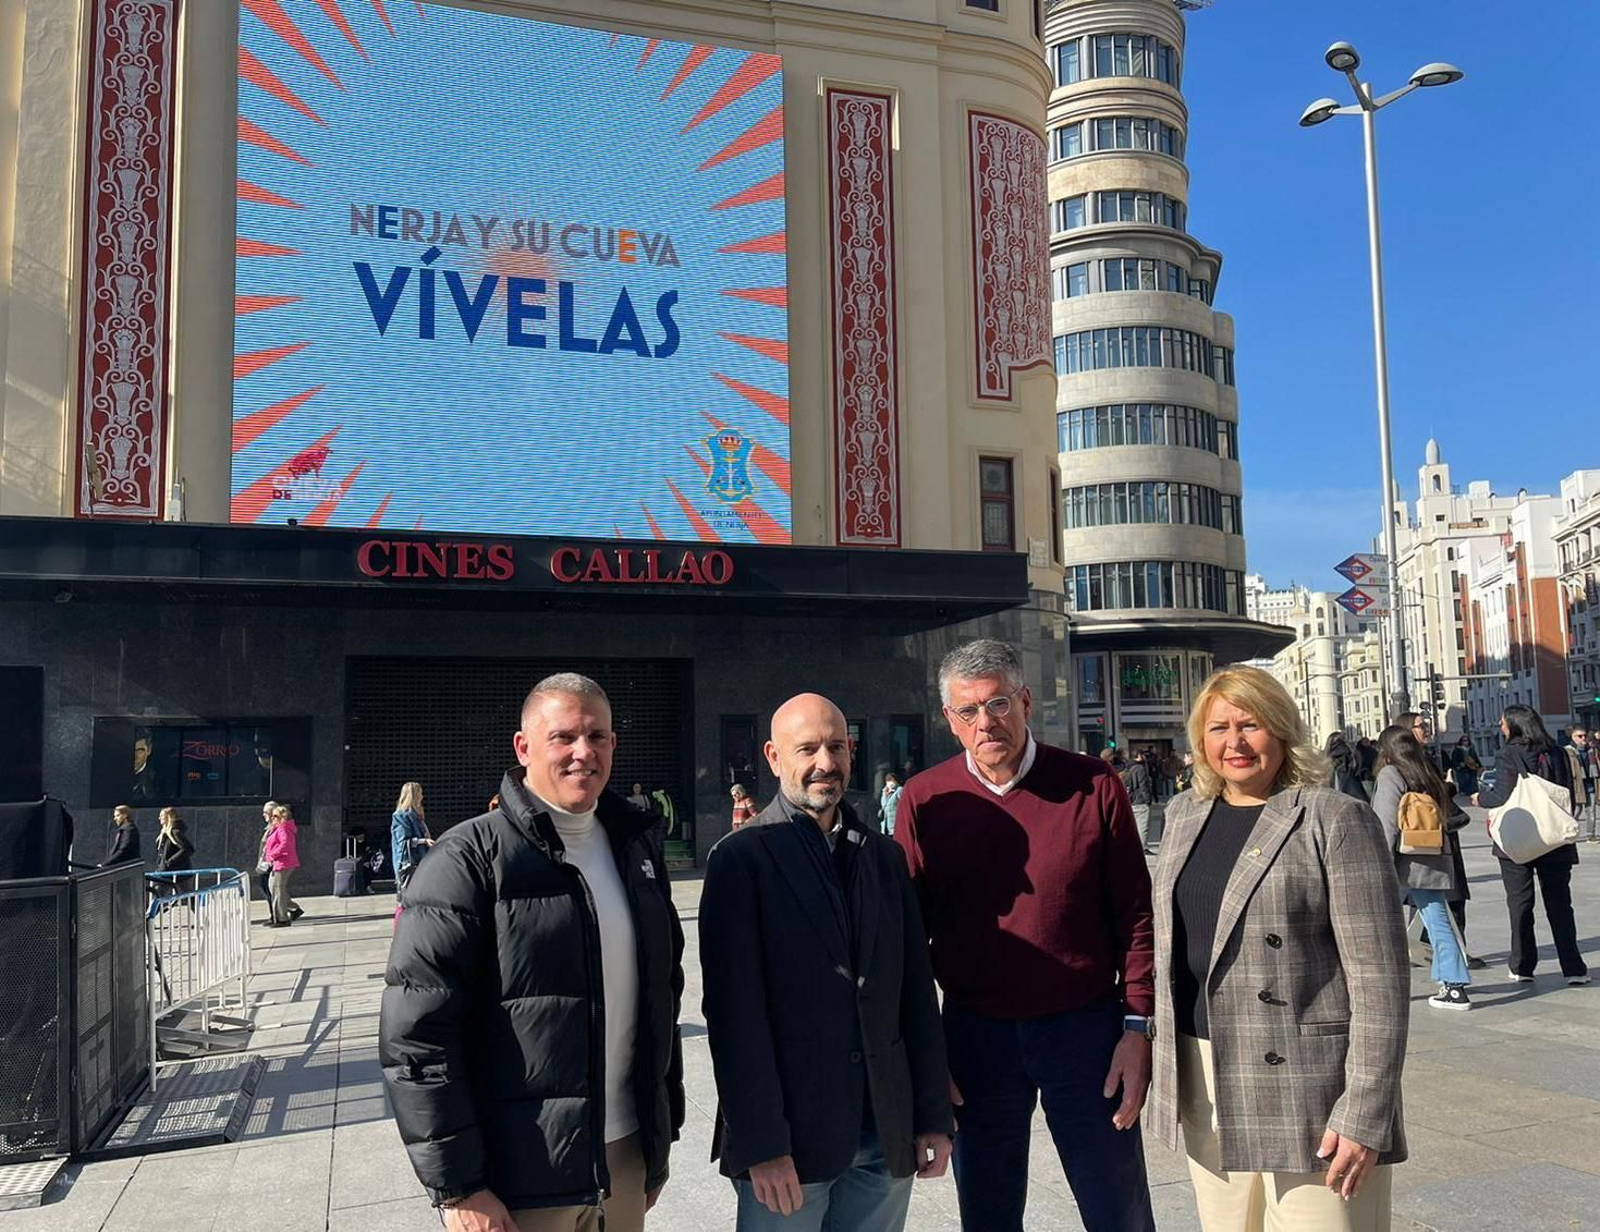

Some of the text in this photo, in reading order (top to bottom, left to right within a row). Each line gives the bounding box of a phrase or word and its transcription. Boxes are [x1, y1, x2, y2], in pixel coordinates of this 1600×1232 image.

[350, 202, 681, 268] NERJA Y SU CUEVA
[352, 245, 681, 359] VÍVELAS
[356, 539, 735, 585] CINES CALLAO
